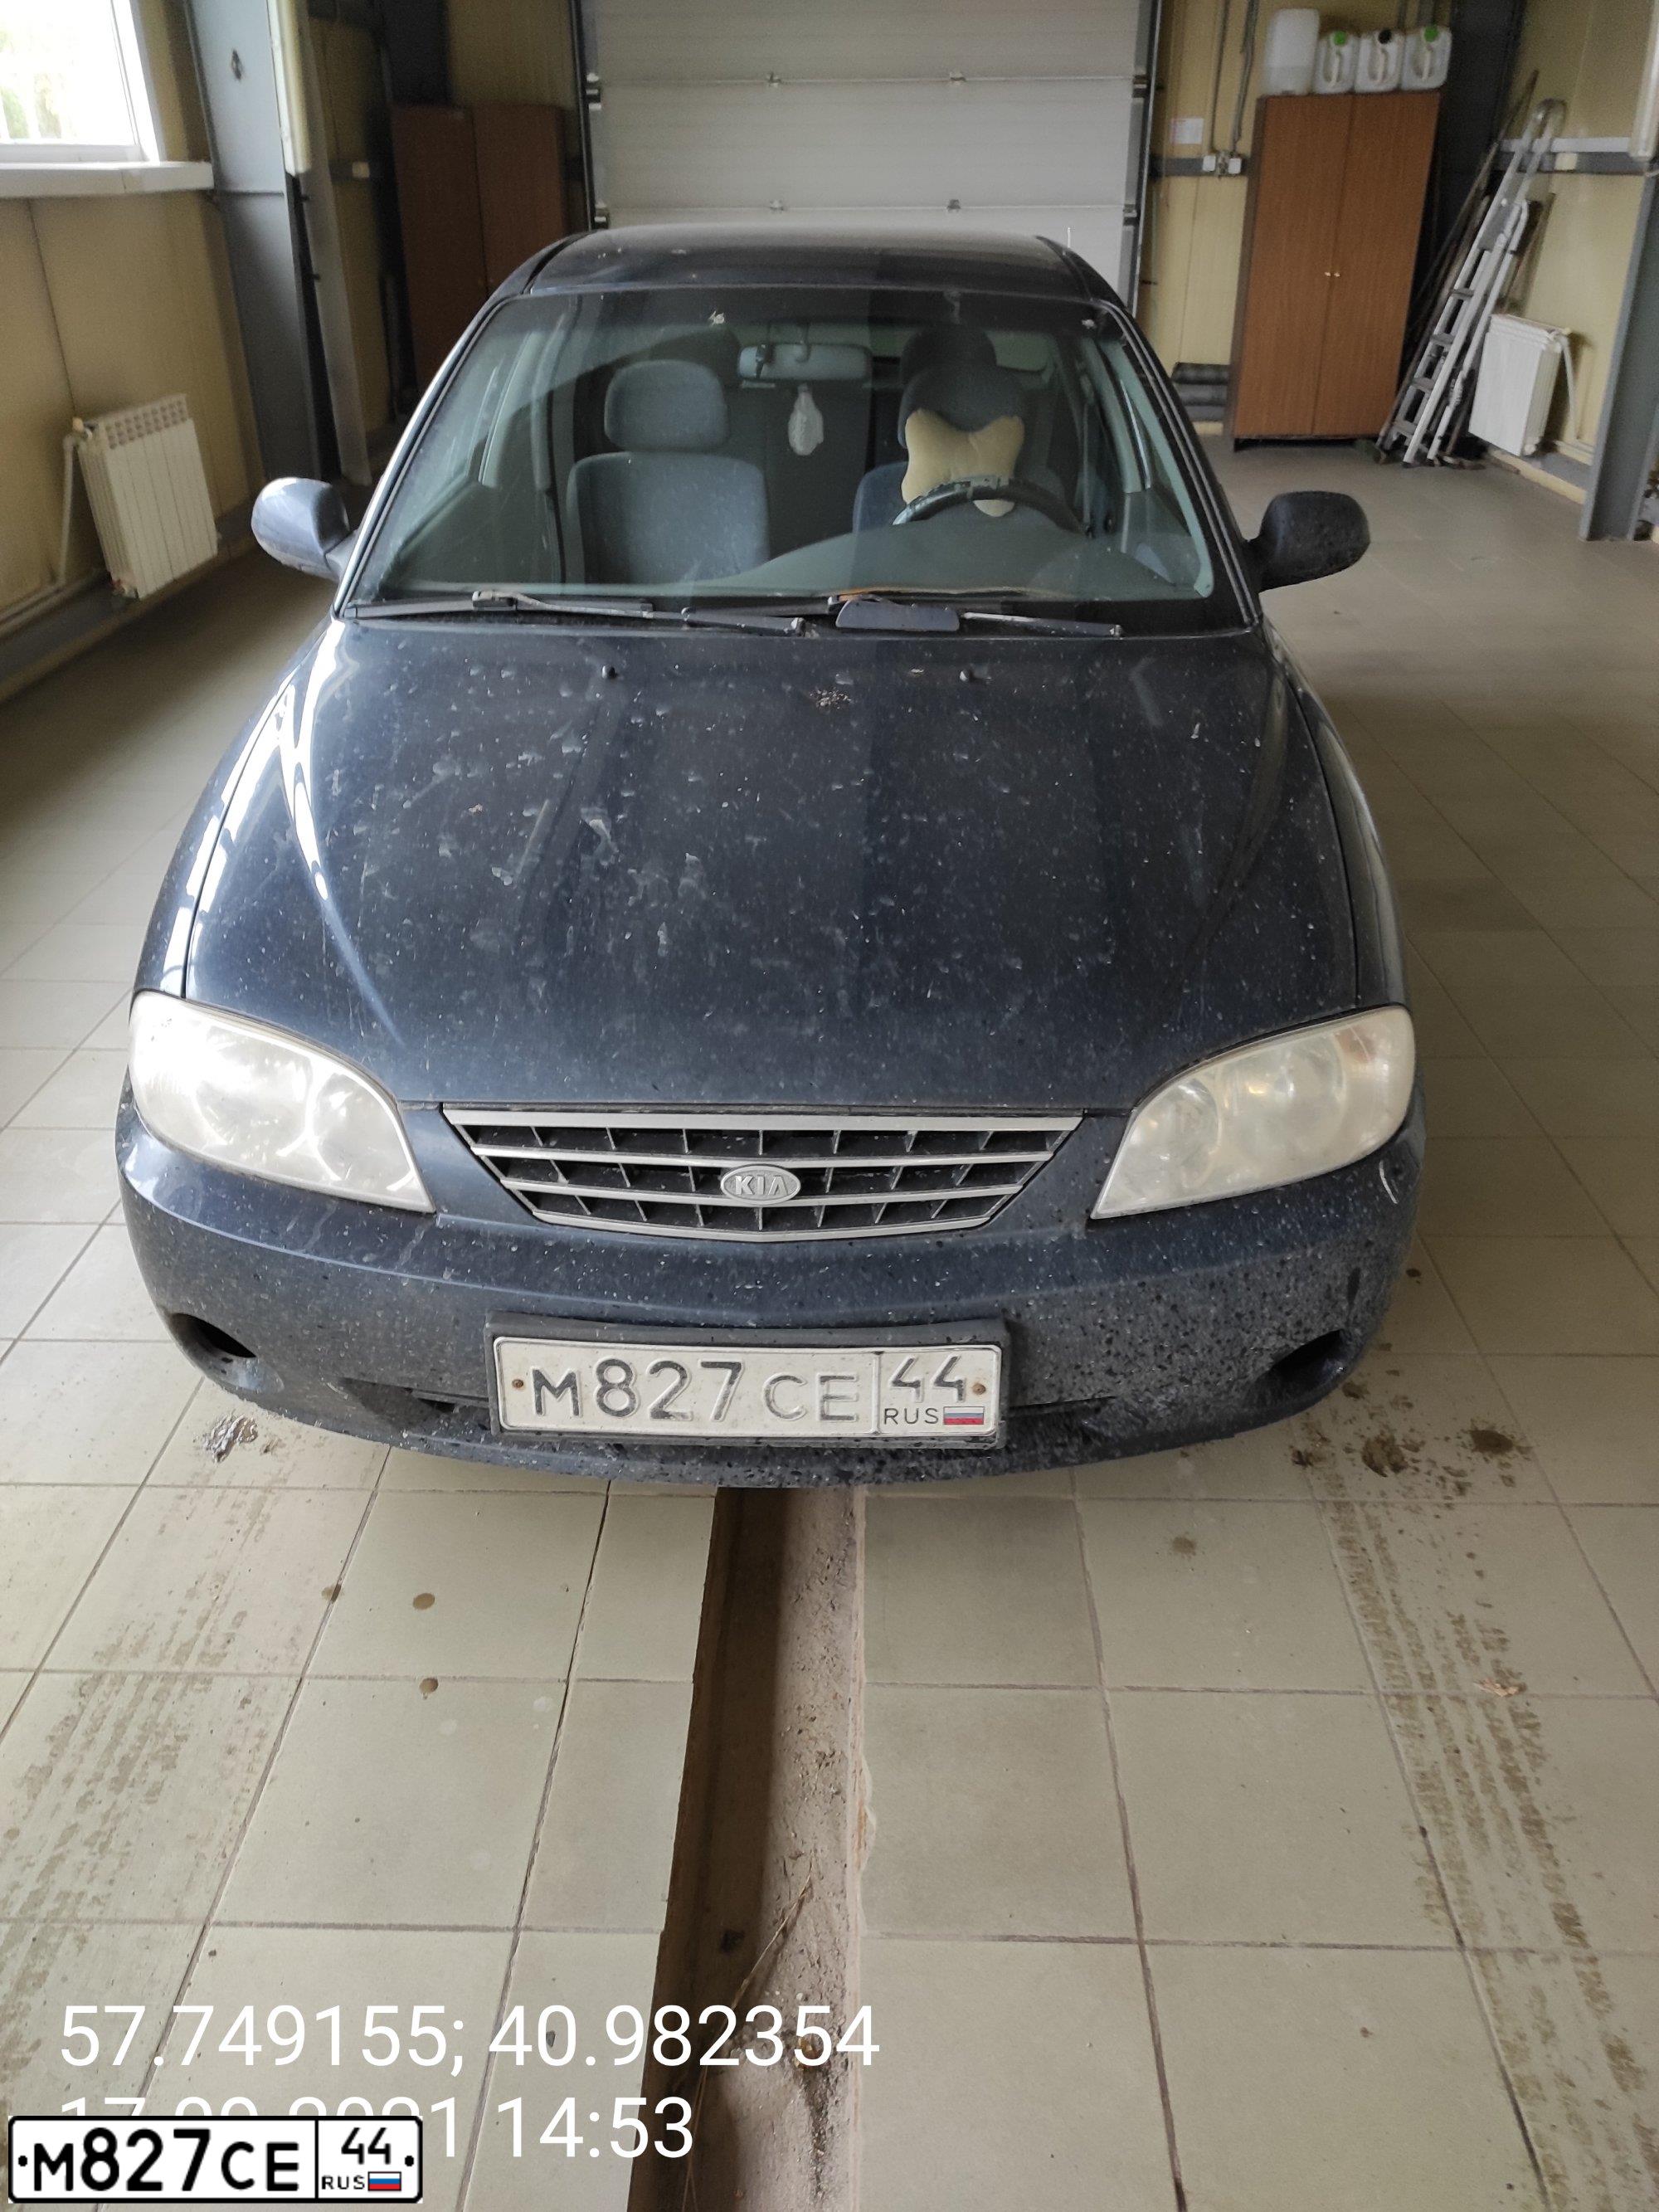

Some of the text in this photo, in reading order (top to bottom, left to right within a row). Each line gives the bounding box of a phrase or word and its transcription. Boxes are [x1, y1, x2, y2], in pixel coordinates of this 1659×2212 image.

[734, 1175, 789, 1196] KIA
[533, 1355, 966, 1422] M827CE 44
[883, 1407, 940, 1426] RUS
